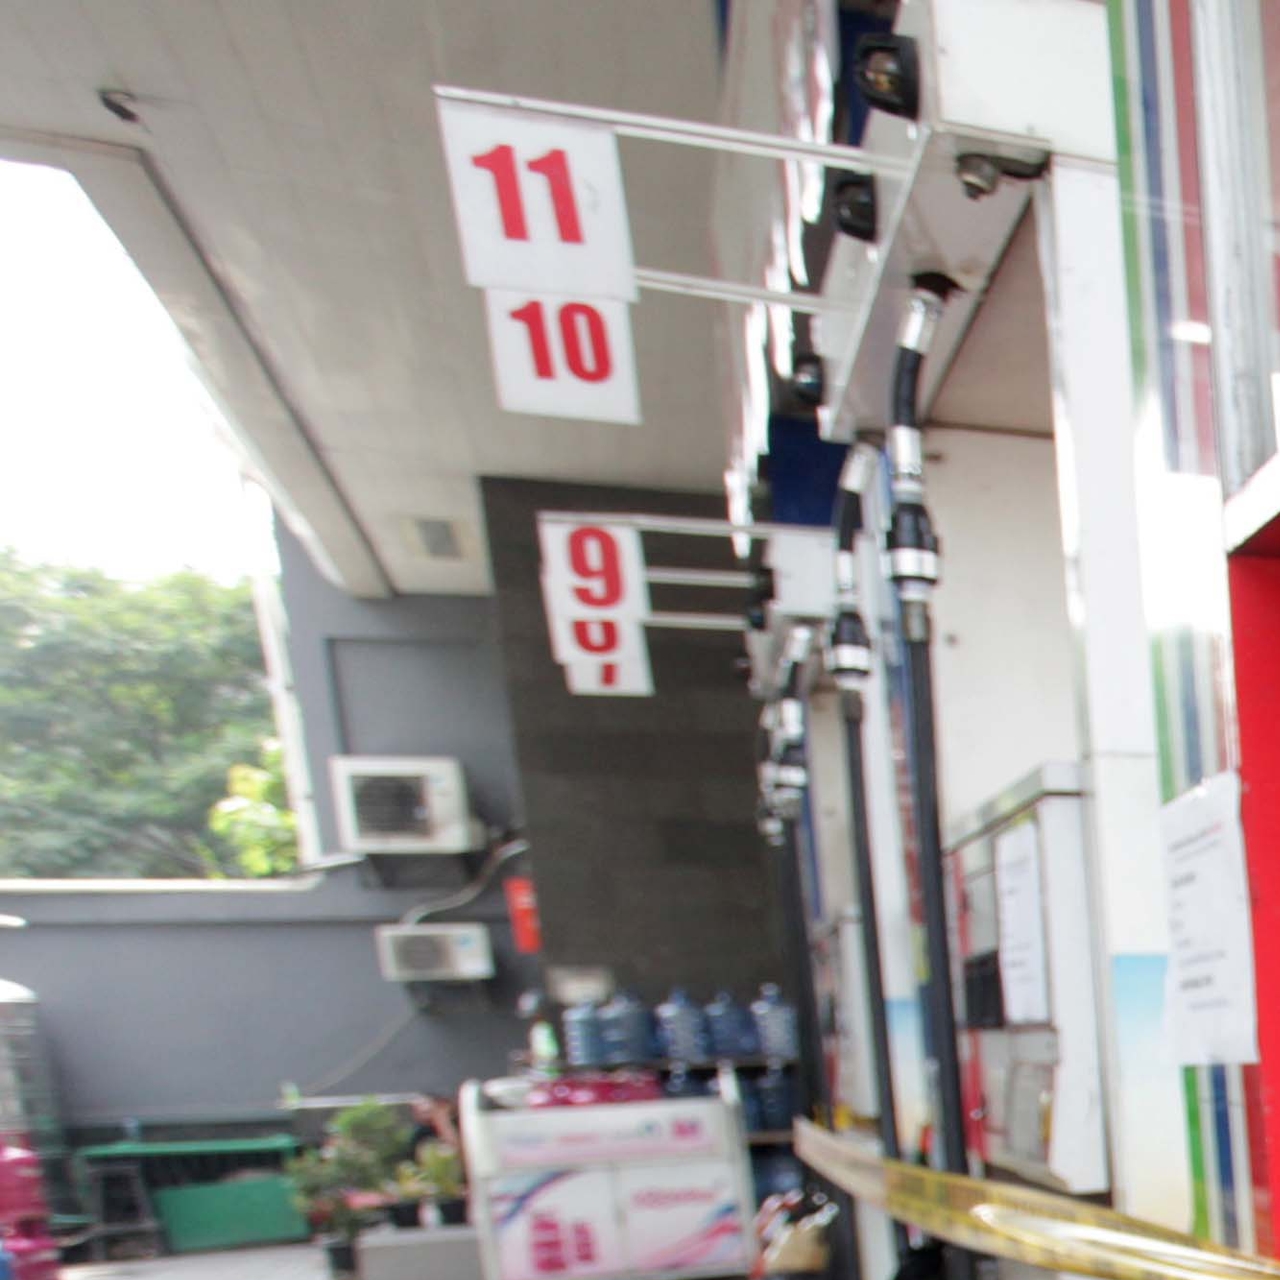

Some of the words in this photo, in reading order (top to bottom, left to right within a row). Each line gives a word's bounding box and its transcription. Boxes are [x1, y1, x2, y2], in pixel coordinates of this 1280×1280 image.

[471, 144, 585, 243] 11
[510, 301, 612, 382] 10
[567, 526, 625, 607] 9
